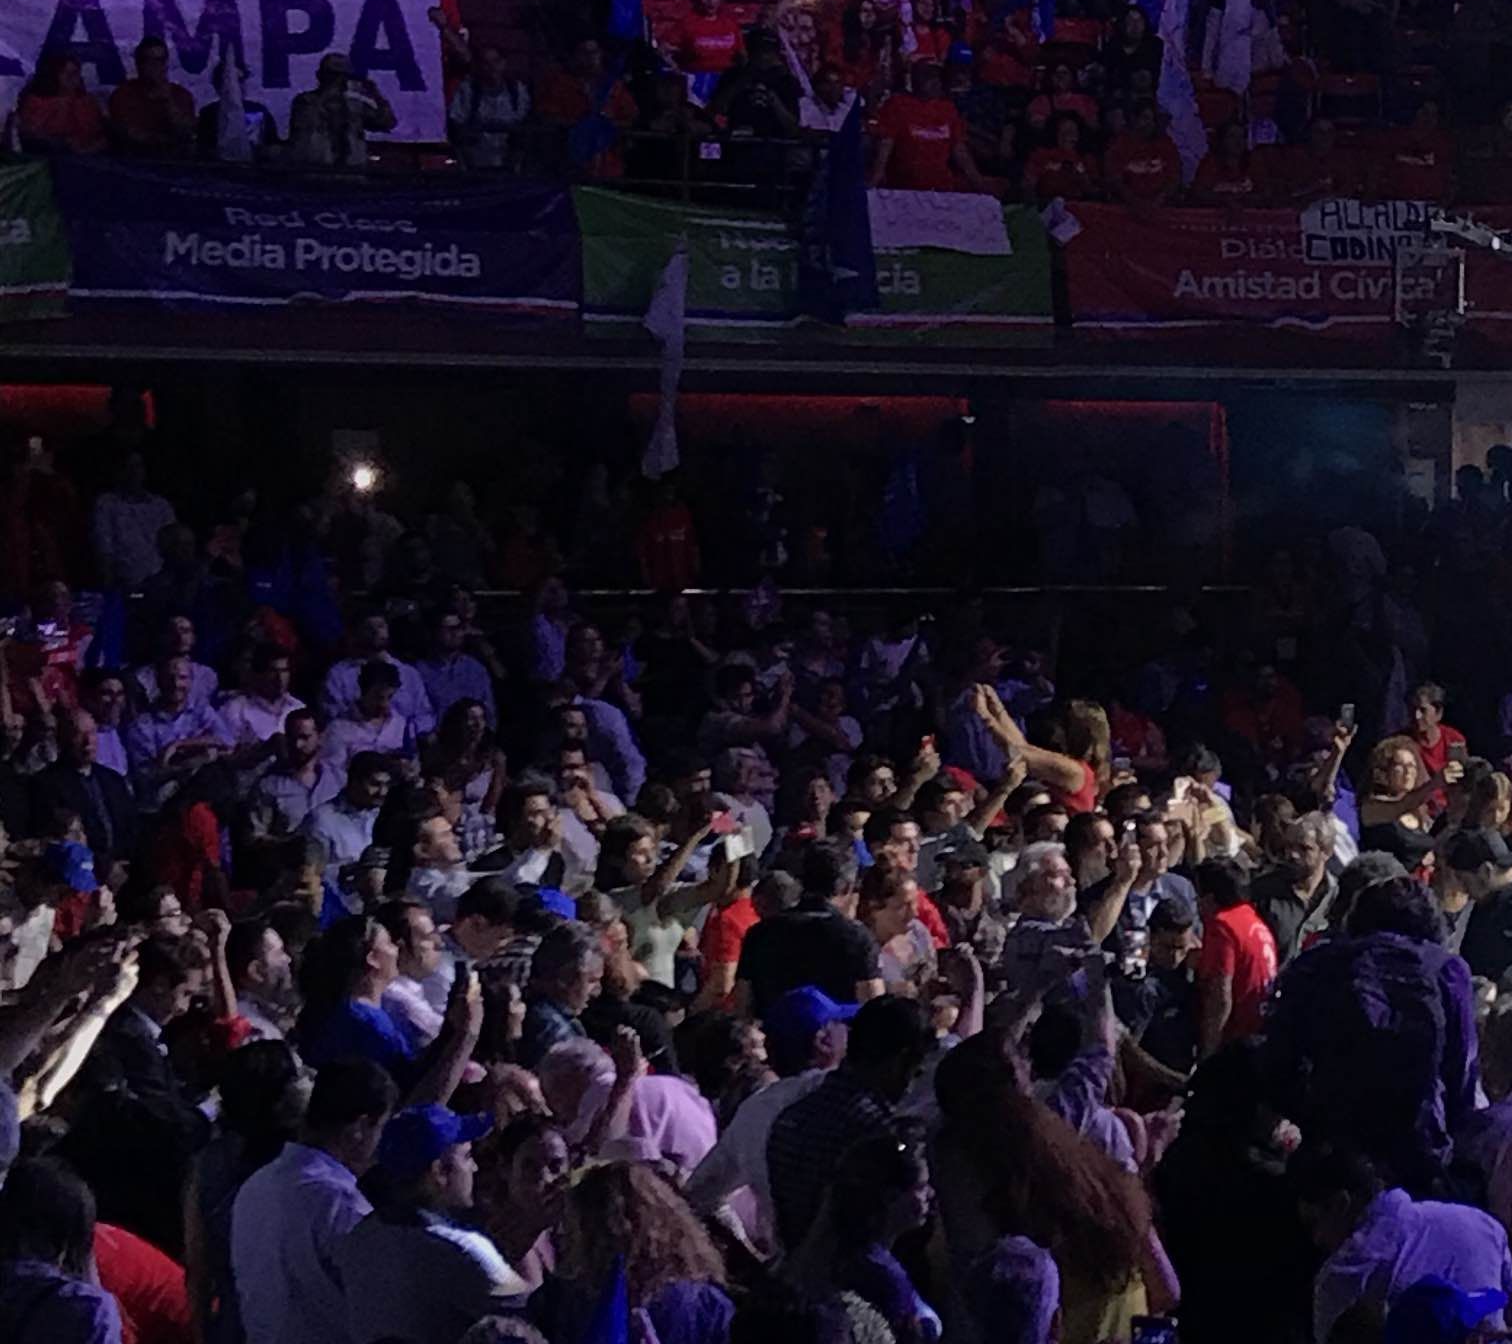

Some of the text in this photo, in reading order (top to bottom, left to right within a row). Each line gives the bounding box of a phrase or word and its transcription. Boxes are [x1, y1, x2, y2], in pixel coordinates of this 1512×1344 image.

[164, 229, 481, 281] Media Protegida
[1173, 268, 1322, 300] Amistad
